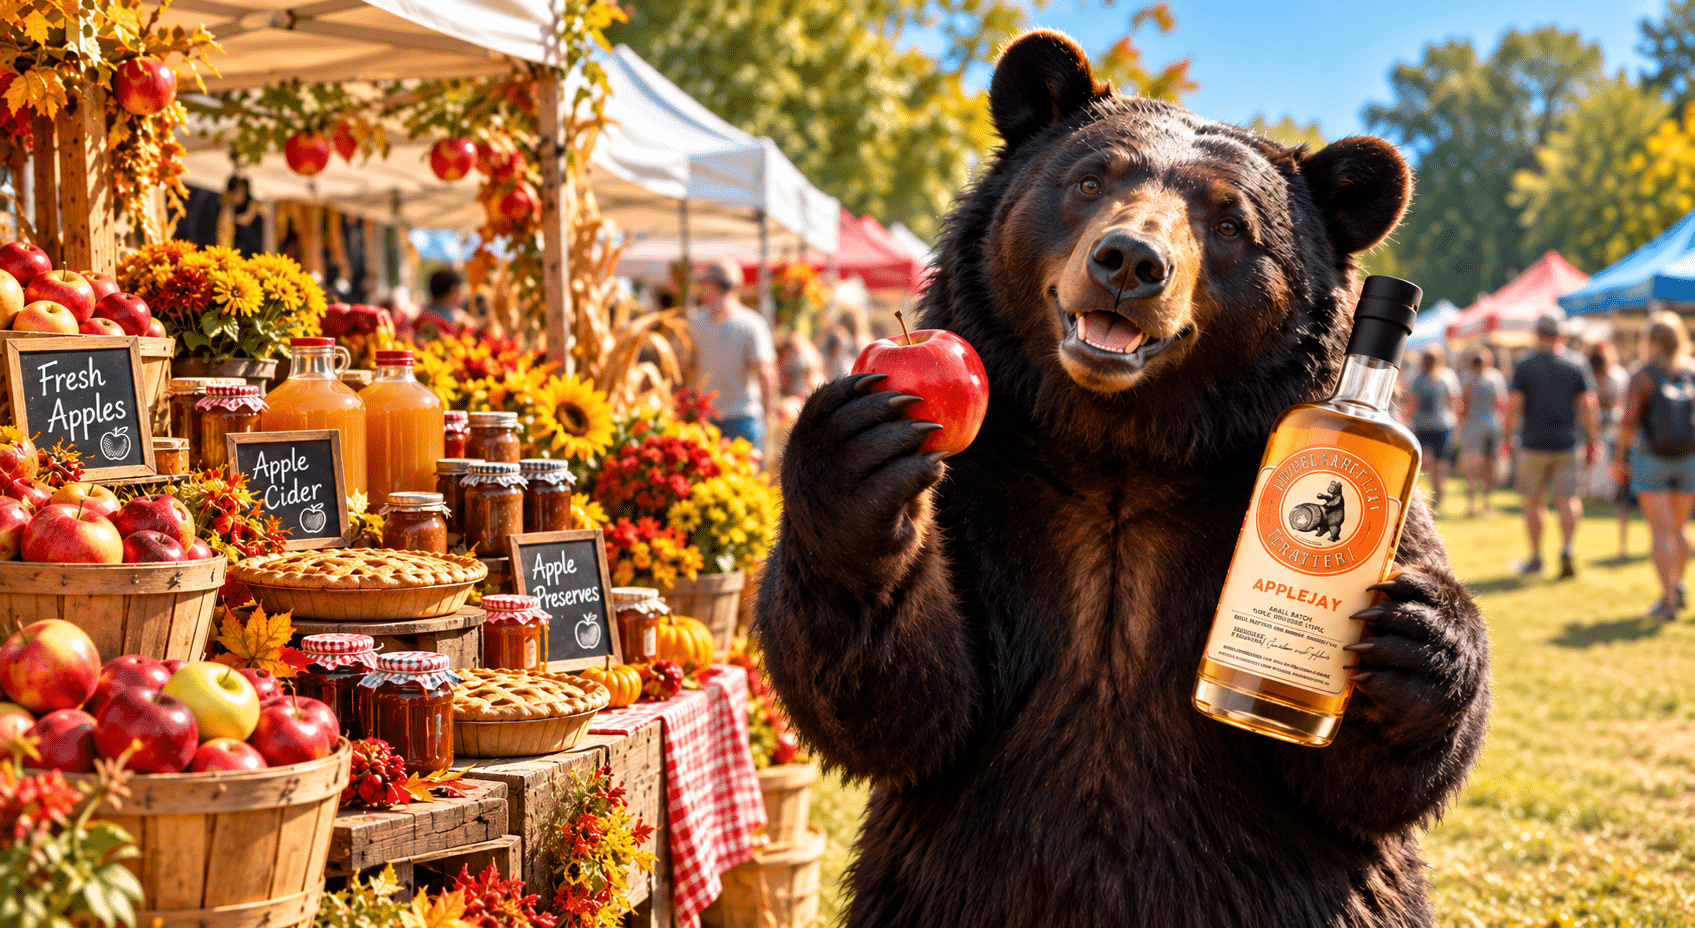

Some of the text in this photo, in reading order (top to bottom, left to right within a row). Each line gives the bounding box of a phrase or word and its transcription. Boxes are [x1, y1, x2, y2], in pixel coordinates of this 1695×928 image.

[37, 356, 106, 396] Fresh
[48, 392, 126, 441] Apples
[252, 446, 309, 484] Apple
[264, 477, 322, 510] Cider
[532, 550, 577, 586] Apple
[532, 585, 600, 609] Preserves
[1252, 577, 1343, 612] APPLEJAY
